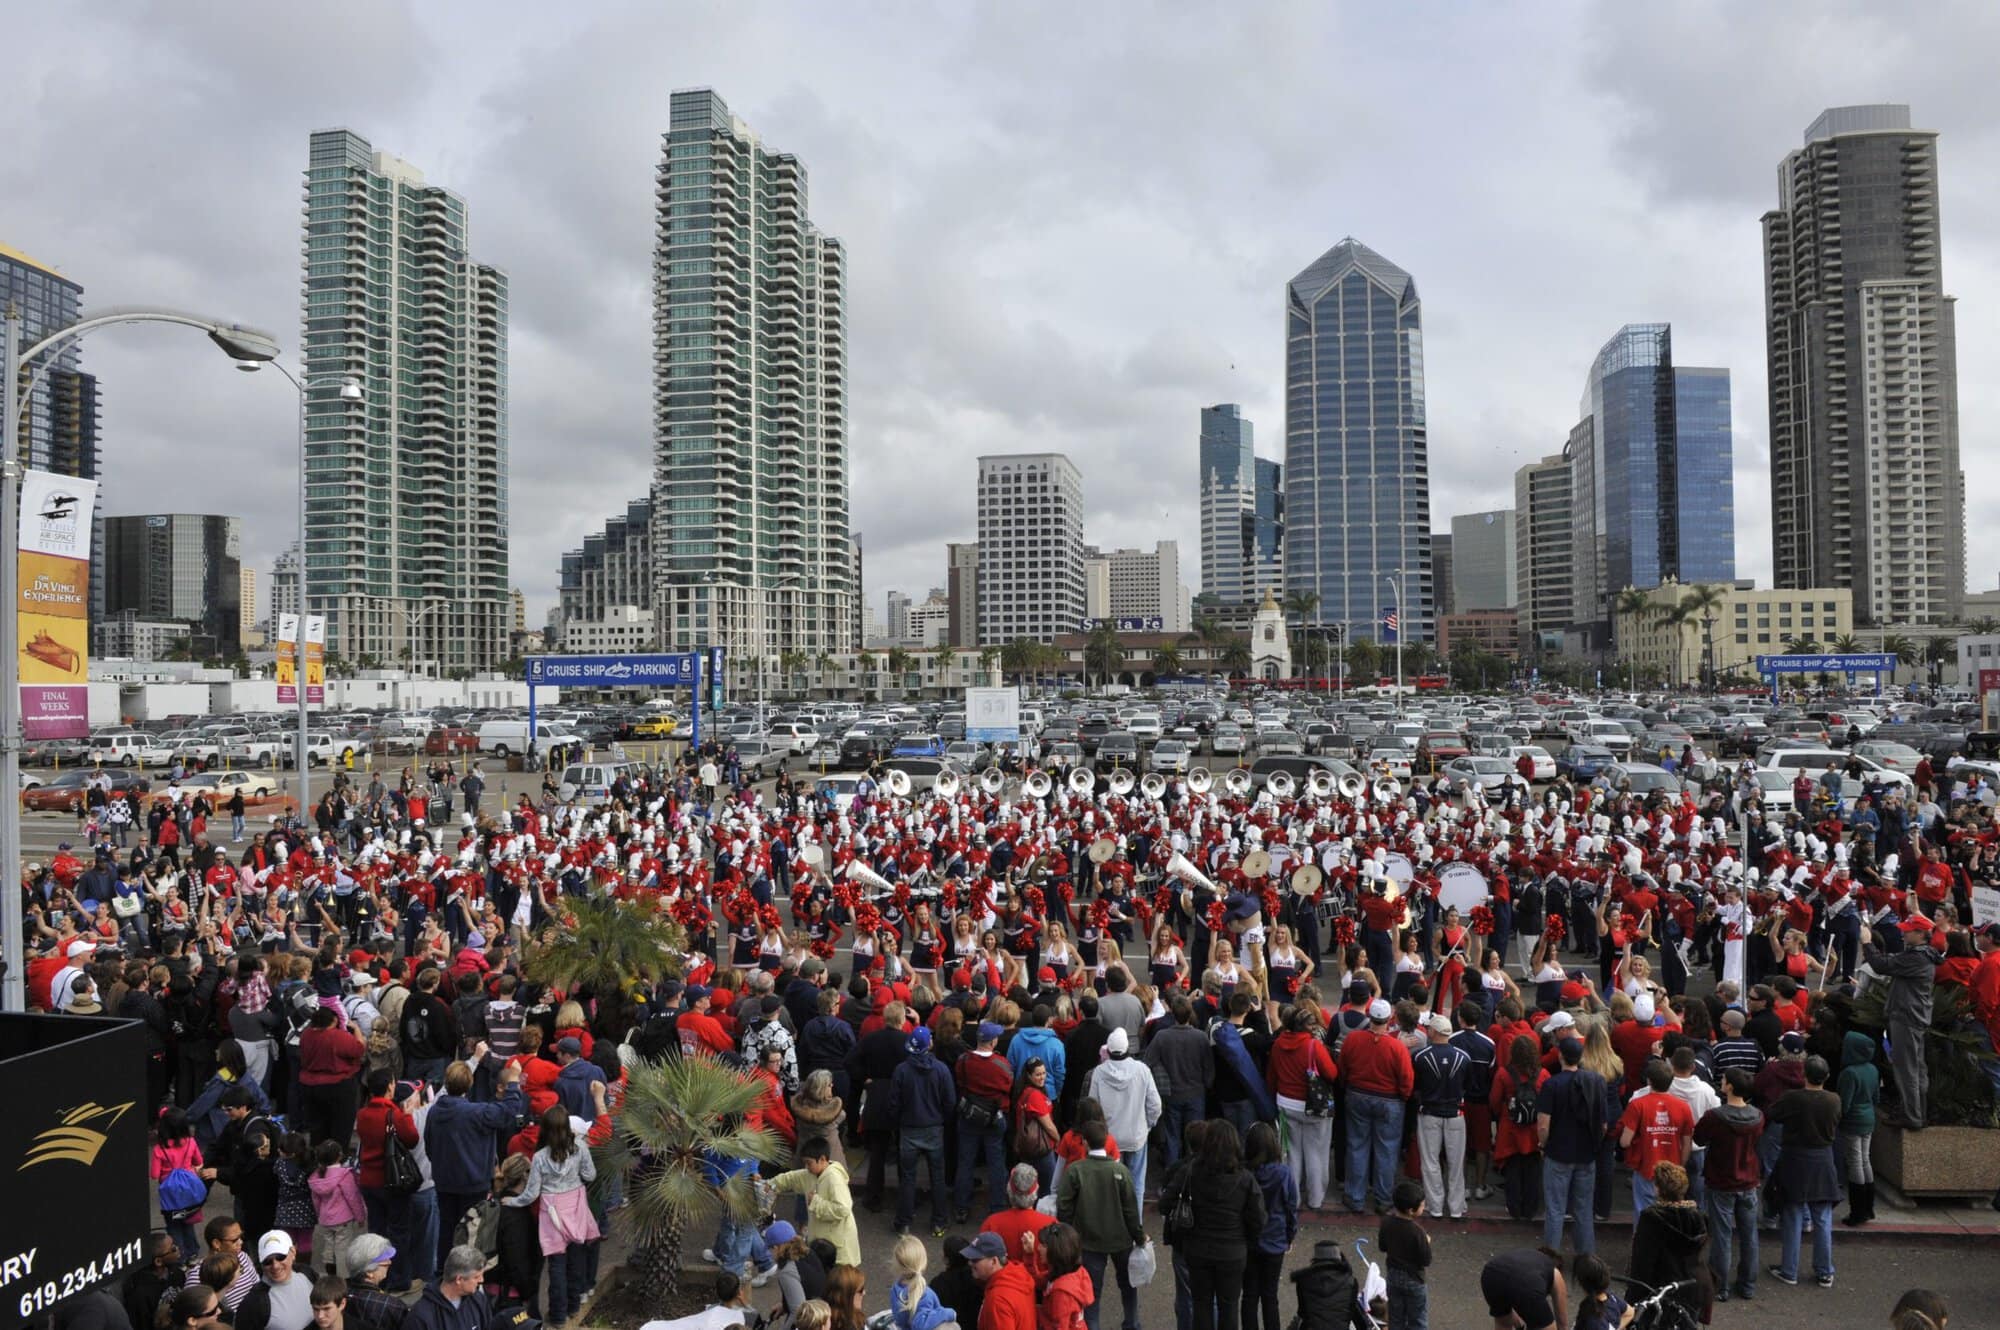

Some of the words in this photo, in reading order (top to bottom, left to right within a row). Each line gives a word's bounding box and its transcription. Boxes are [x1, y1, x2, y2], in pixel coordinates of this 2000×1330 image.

[54, 532, 76, 541] SPACE
[1083, 618, 1133, 631] Sata
[1142, 617, 1161, 629] Fe
[1771, 660, 1802, 668] CRUISE
[1803, 659, 1822, 667] SHIP
[1844, 658, 1881, 667] PARKING
[546, 664, 582, 677] CRUISE
[583, 664, 606, 677] SHIP
[633, 663, 676, 676] PARKING
[42, 691, 69, 701] FINAL
[40, 702, 70, 712] WEEKS
[0, 1247, 37, 1288] RY
[20, 1237, 142, 1317] 619.234.4111
